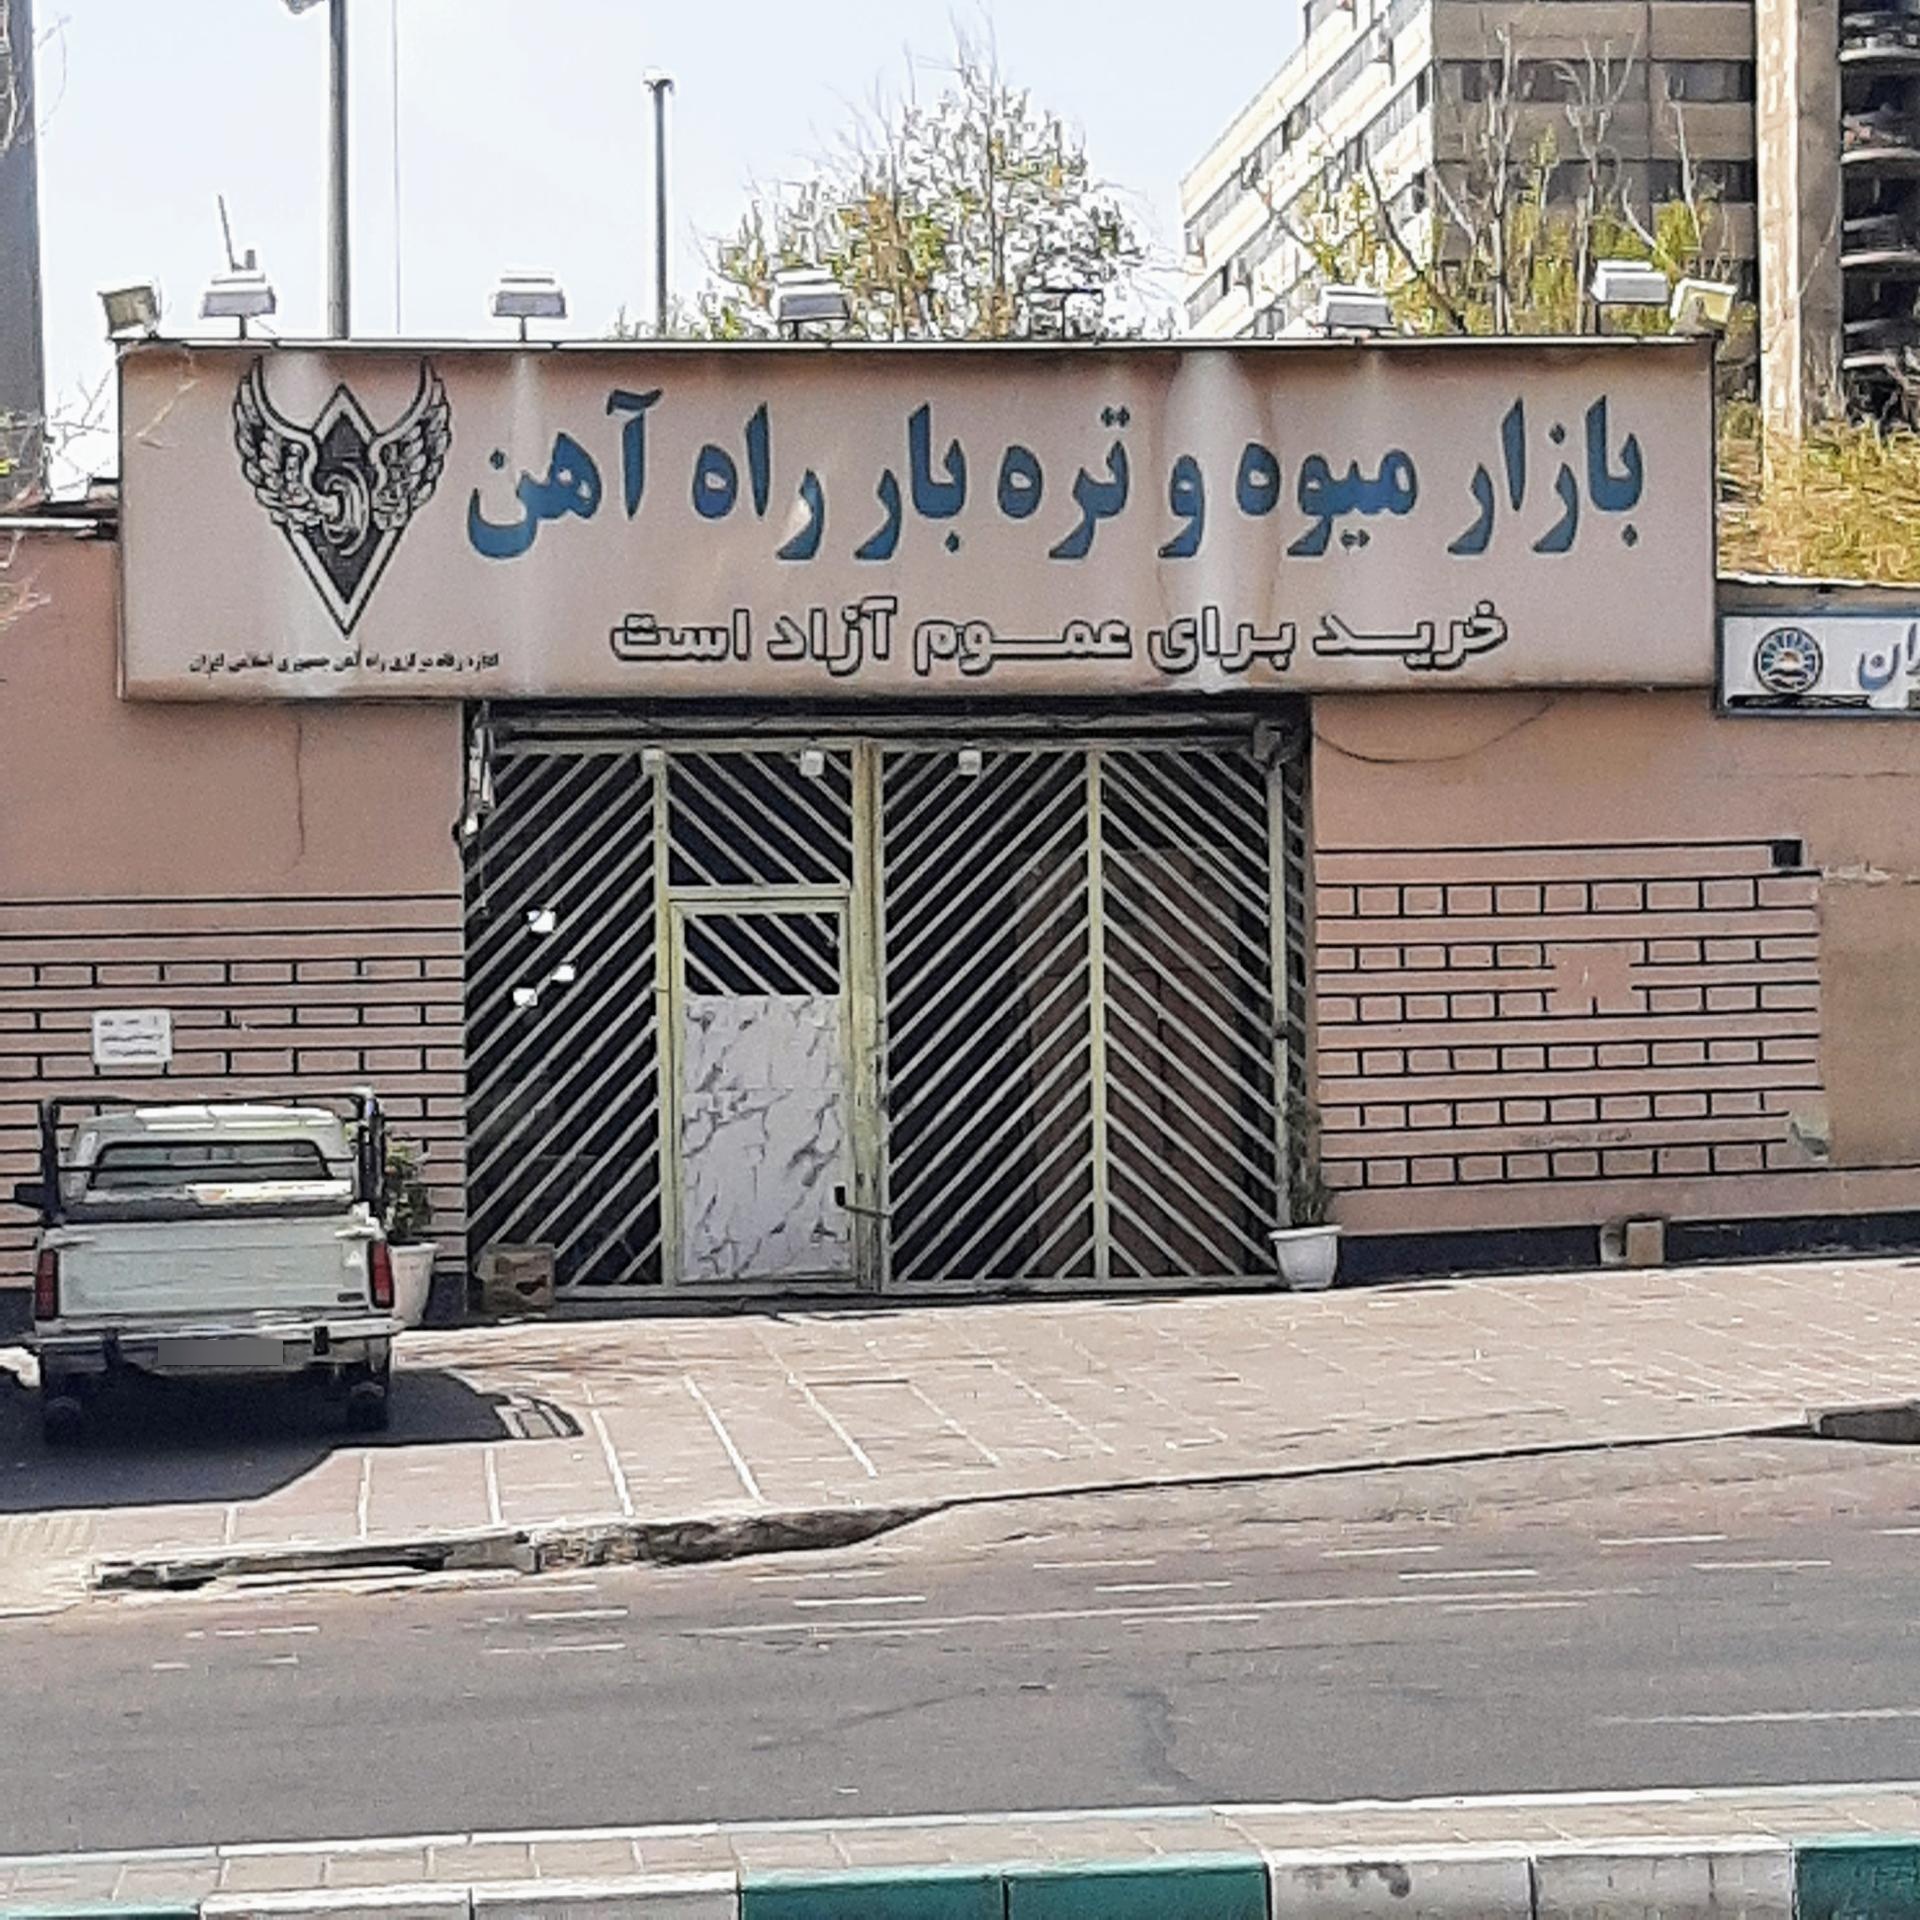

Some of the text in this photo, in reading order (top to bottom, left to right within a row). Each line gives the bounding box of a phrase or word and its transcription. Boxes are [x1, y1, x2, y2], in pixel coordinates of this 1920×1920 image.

[466, 388, 1643, 560] بازار میوه و تره بار راه آهن
[609, 596, 1508, 678] خرید برای عموم آزاد است
[1857, 622, 1920, 691] ان
